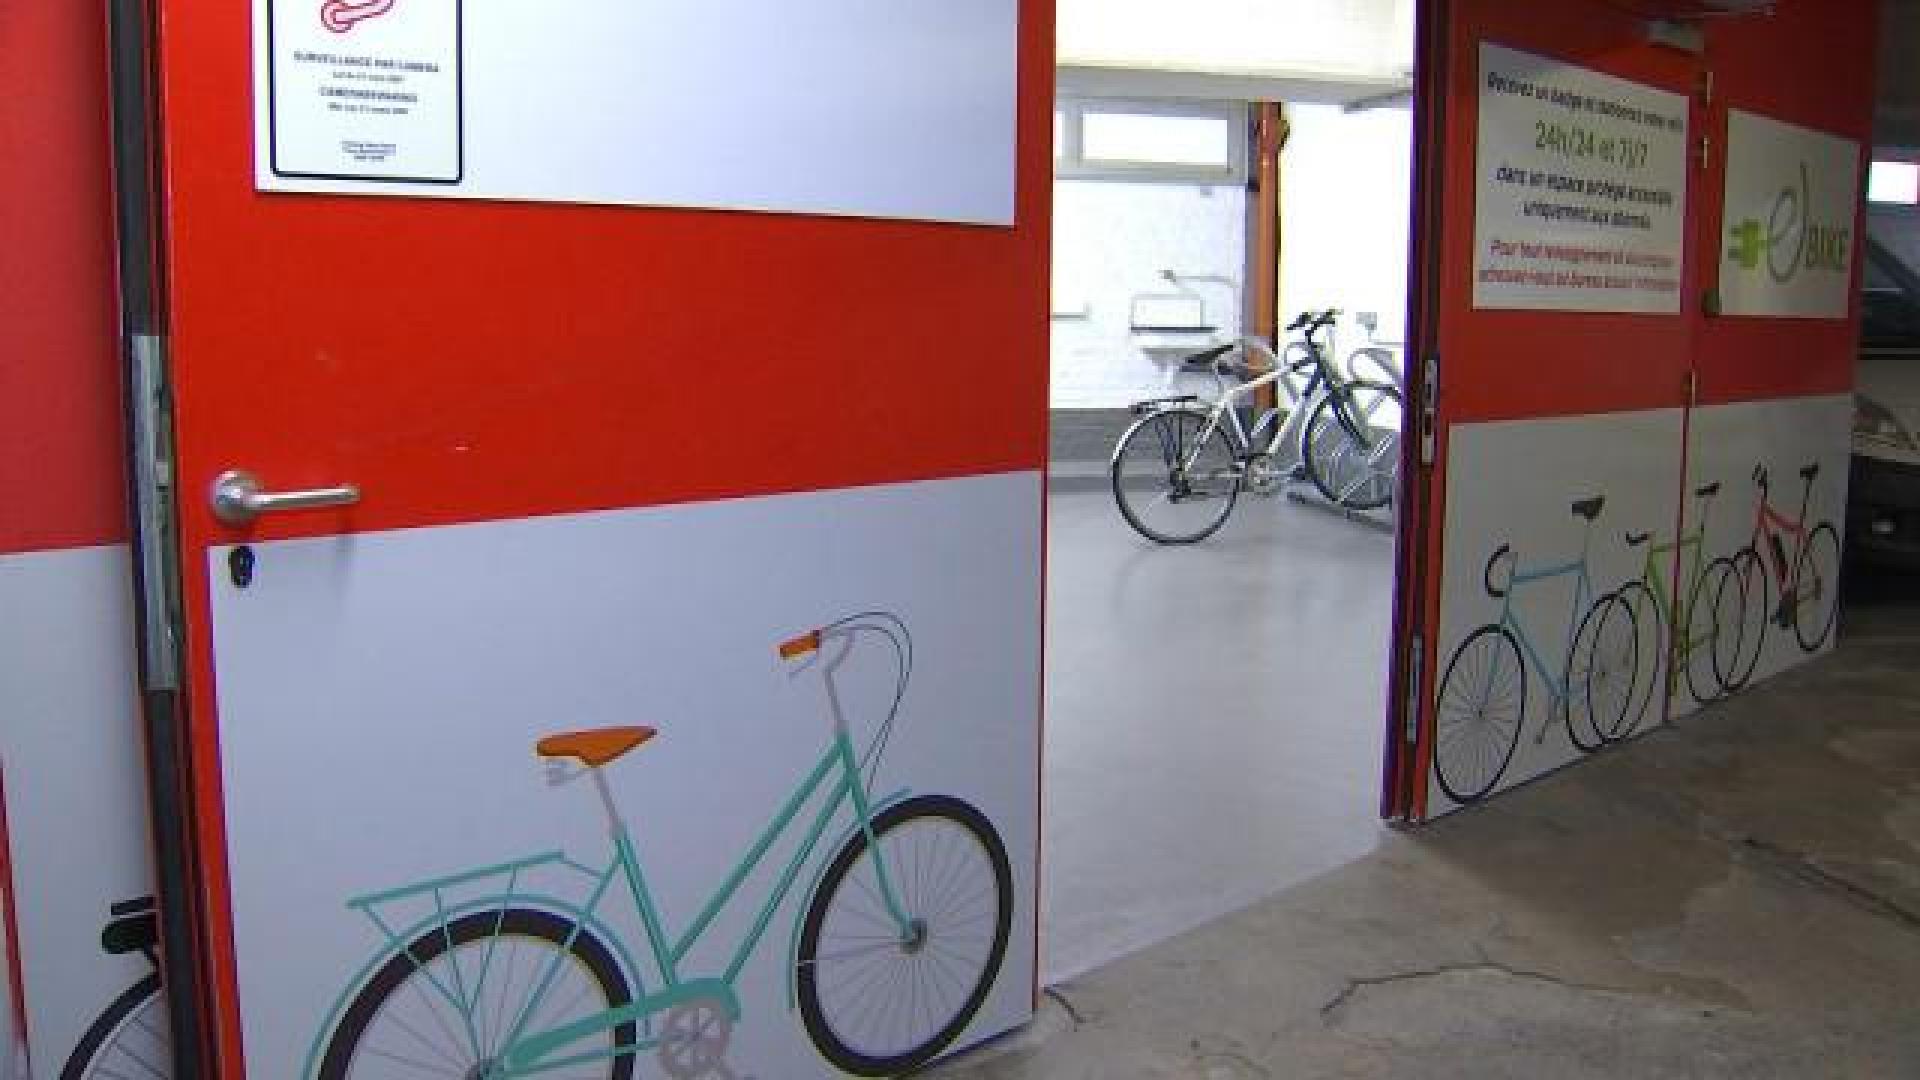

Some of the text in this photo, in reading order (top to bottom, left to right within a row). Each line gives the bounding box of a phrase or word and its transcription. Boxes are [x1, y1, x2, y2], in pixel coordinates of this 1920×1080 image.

[1535, 120, 1648, 168] 24h/24 et 7j/7
[1496, 160, 1526, 187] dans
[1529, 173, 1544, 189] un
